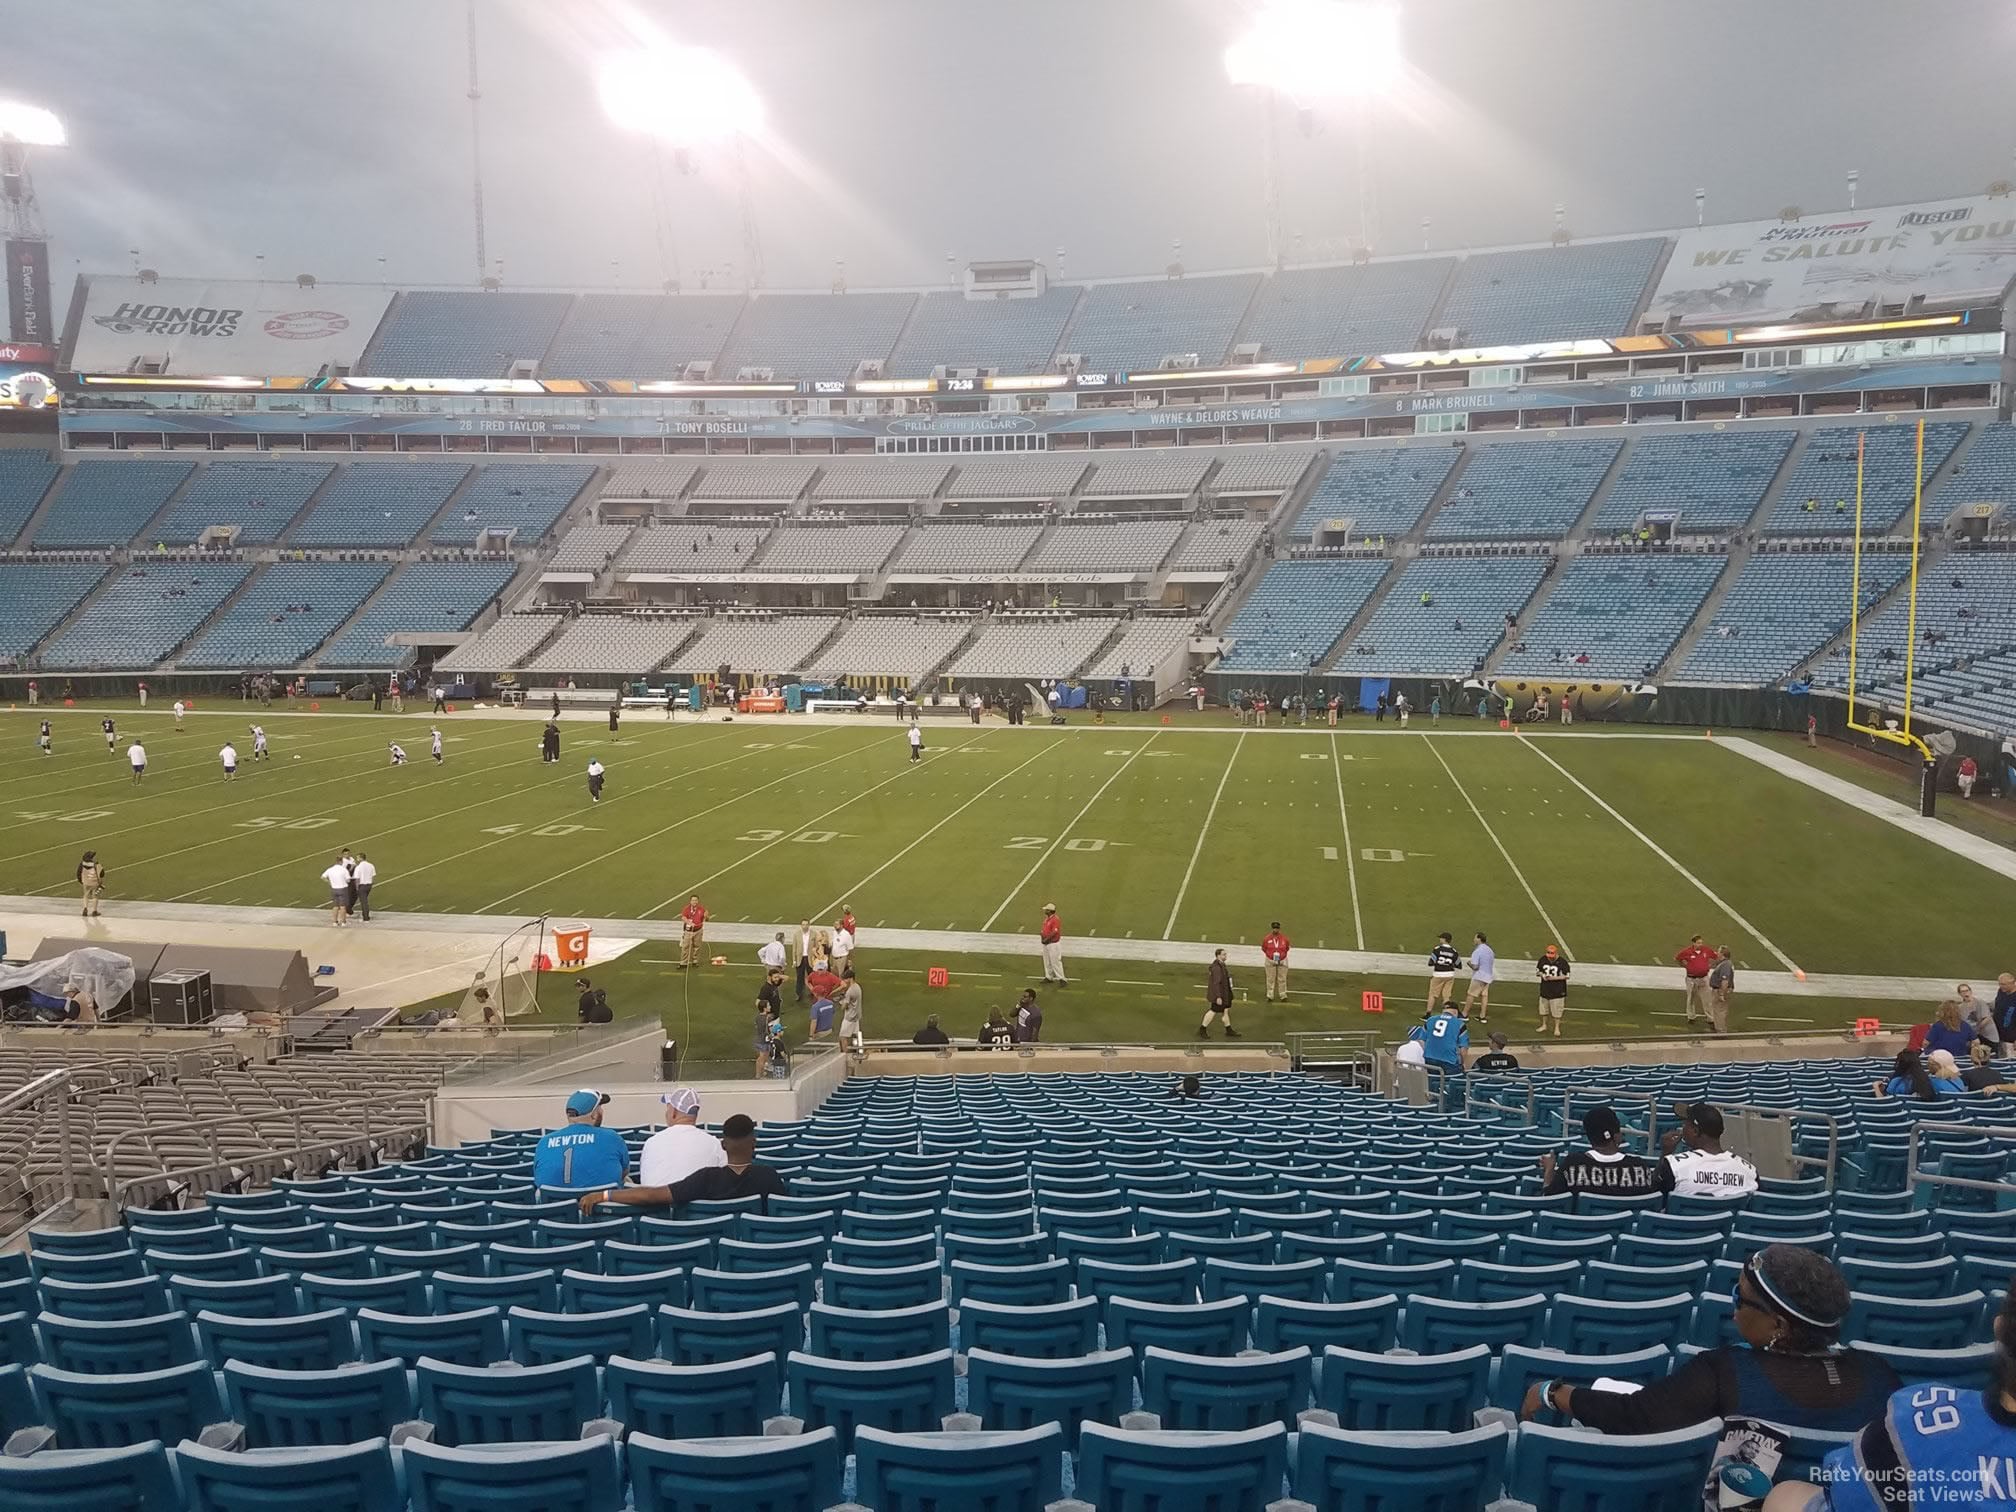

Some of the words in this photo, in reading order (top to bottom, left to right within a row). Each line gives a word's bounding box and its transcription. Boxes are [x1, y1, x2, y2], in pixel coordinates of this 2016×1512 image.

[1693, 249, 1750, 266] WE
[1761, 231, 1913, 263] SALUTE
[1930, 220, 2016, 246] YOU
[112, 303, 244, 326] HONOR
[24, 311, 37, 336] Field
[144, 320, 238, 337] ROWS
[1630, 386, 1644, 398] 82
[1652, 383, 1689, 397] JIMMY
[1691, 381, 1725, 394] SMITH
[1396, 400, 1403, 412] 8
[1412, 398, 1443, 411] MARK
[1446, 395, 1495, 409] BRUNELL
[1150, 412, 1184, 425] WAYNE
[1185, 412, 1193, 423] &
[1195, 410, 1239, 423] DELORES
[1241, 408, 1281, 421] WEAVER
[480, 421, 505, 431] FRED
[509, 421, 546, 432] TAYLOR
[659, 423, 670, 433] 71
[675, 422, 703, 433] TONY
[706, 422, 748, 433] BOSELLI
[904, 421, 936, 432] PRIDE
[971, 419, 1017, 430] JAGUARS
[1063, 574, 1102, 582] Club
[232, 816, 340, 830] 50
[479, 823, 585, 836] 40
[735, 829, 840, 843] 30
[1002, 836, 1108, 851] 20
[1315, 846, 1405, 862] 10
[568, 935, 585, 953] G
[930, 970, 944, 985] 20
[1542, 964, 1559, 977] 33
[1366, 994, 1380, 1009] 10
[1432, 1019, 1448, 1037] 9
[548, 1133, 595, 1149] NEWTON
[562, 1147, 573, 1185] 1
[1694, 1170, 1745, 1187] JONES-DREW
[1911, 1386, 1961, 1436] 59
[1724, 1429, 1782, 1453] GAMEDAY
